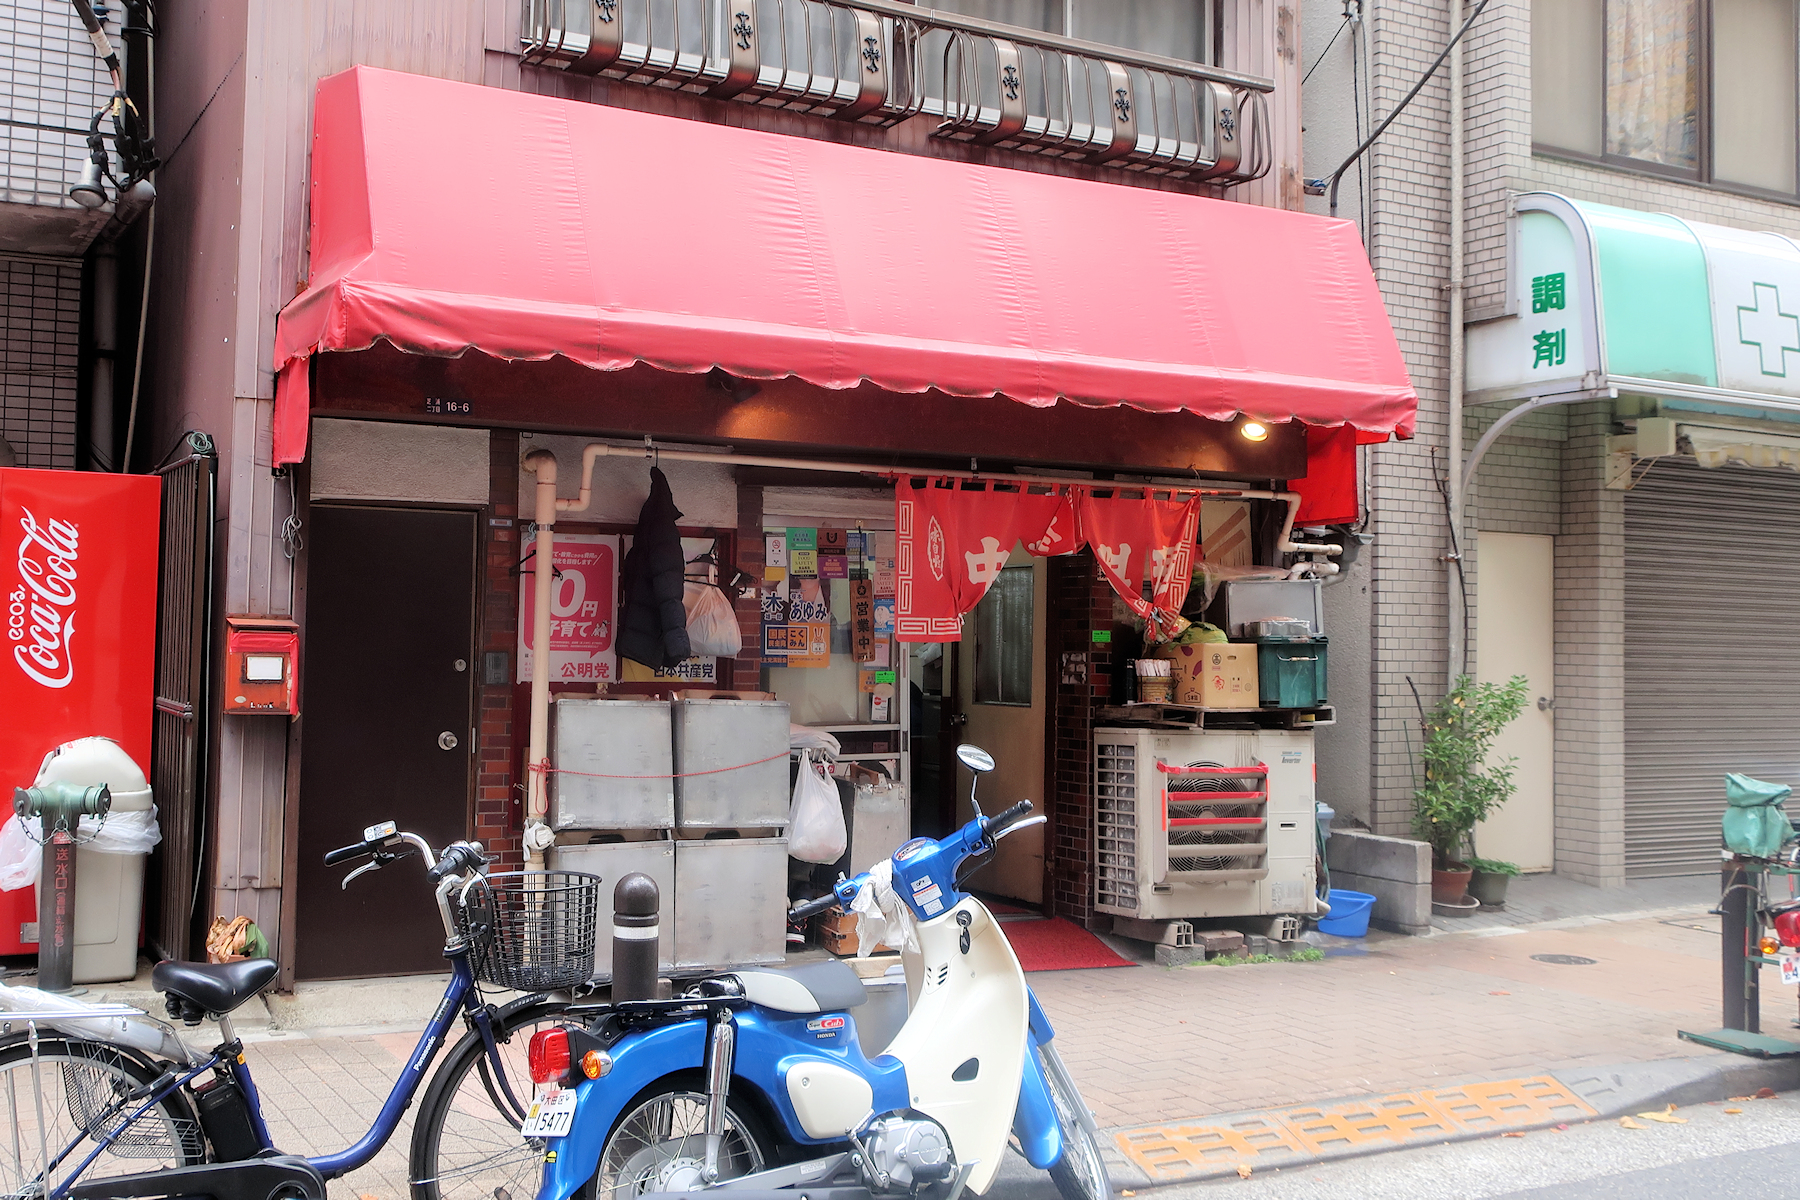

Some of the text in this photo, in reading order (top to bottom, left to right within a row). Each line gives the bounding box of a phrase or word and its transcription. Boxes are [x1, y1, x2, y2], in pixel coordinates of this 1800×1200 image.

[1532, 272, 1565, 369] 調剤
[446, 401, 470, 413] 16-6
[14, 505, 79, 689] Coca-Cola
[790, 602, 828, 620] あゆみ
[790, 630, 804, 638] こく
[856, 601, 870, 650] 営業中
[561, 662, 609, 679] 公明党
[55, 848, 69, 889] 送水口
[824, 1018, 842, 1028] Cub
[412, 1035, 437, 1071] Panasonic
[544, 1095, 565, 1106] 大田区
[533, 1112, 570, 1132] 15477
